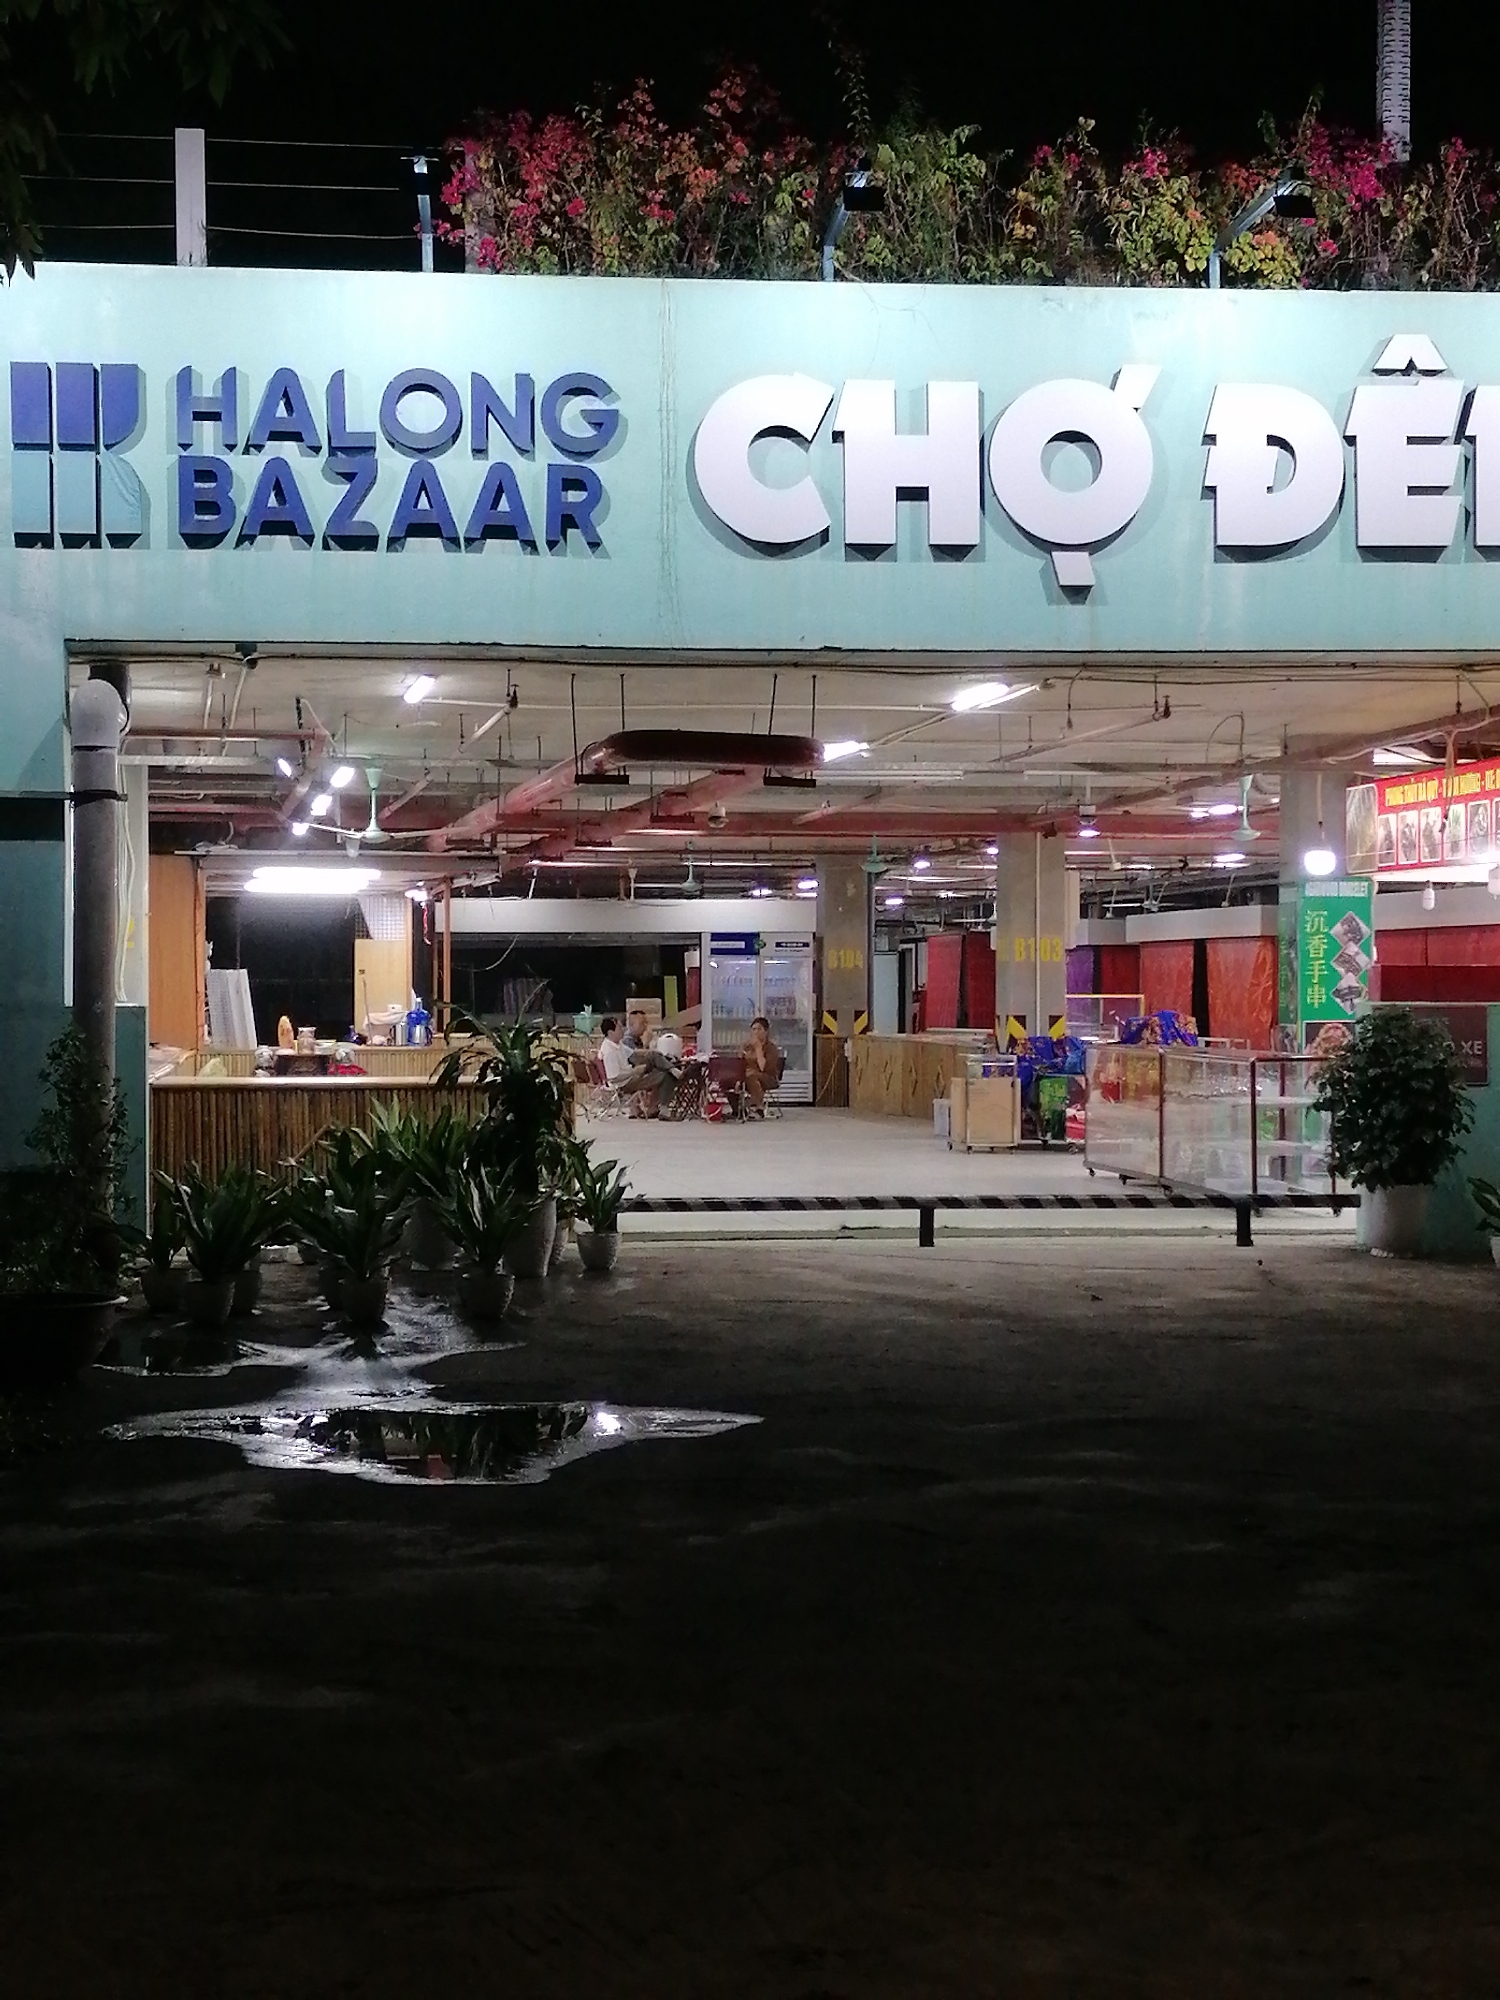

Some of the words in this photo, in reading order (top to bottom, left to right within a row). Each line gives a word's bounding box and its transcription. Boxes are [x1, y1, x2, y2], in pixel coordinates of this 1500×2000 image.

[176, 365, 620, 458] HALONG
[178, 455, 604, 551] BAZAAR
[693, 363, 1162, 587] CHỢ
[1014, 937, 1063, 962] B103
[1305, 908, 1329, 1009] 沉香手串
[1460, 1040, 1483, 1055] XE
